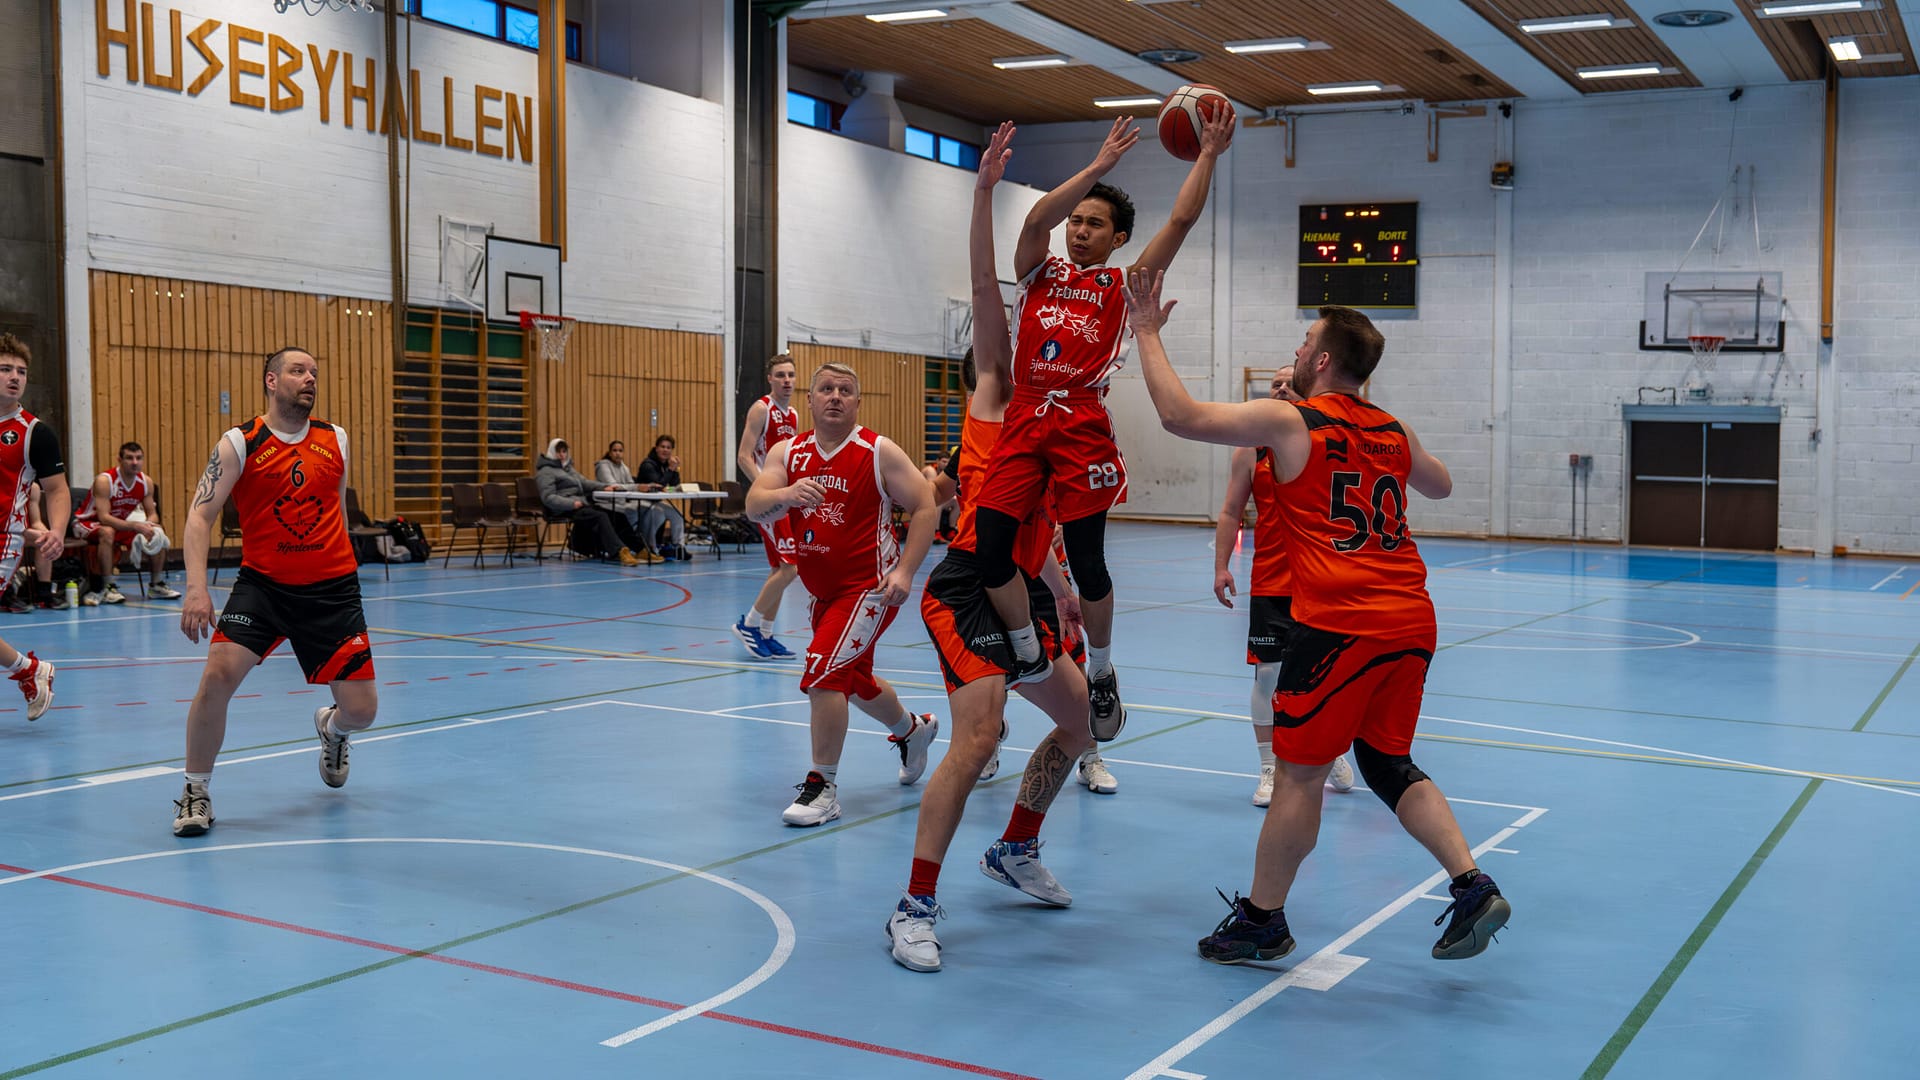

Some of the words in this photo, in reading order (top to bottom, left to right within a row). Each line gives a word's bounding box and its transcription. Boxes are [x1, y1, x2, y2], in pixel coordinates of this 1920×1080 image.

[95, 0, 533, 163] HUSEBYHALLEN
[1303, 232, 1341, 242] HJEMME
[1378, 231, 1408, 241] BORTE
[255, 446, 278, 464] EXTRA
[310, 443, 333, 460] EXTRA
[1357, 443, 1402, 455] DAROS
[291, 459, 305, 488] 6
[1088, 462, 1118, 489] 28
[1329, 471, 1405, 552] 50
